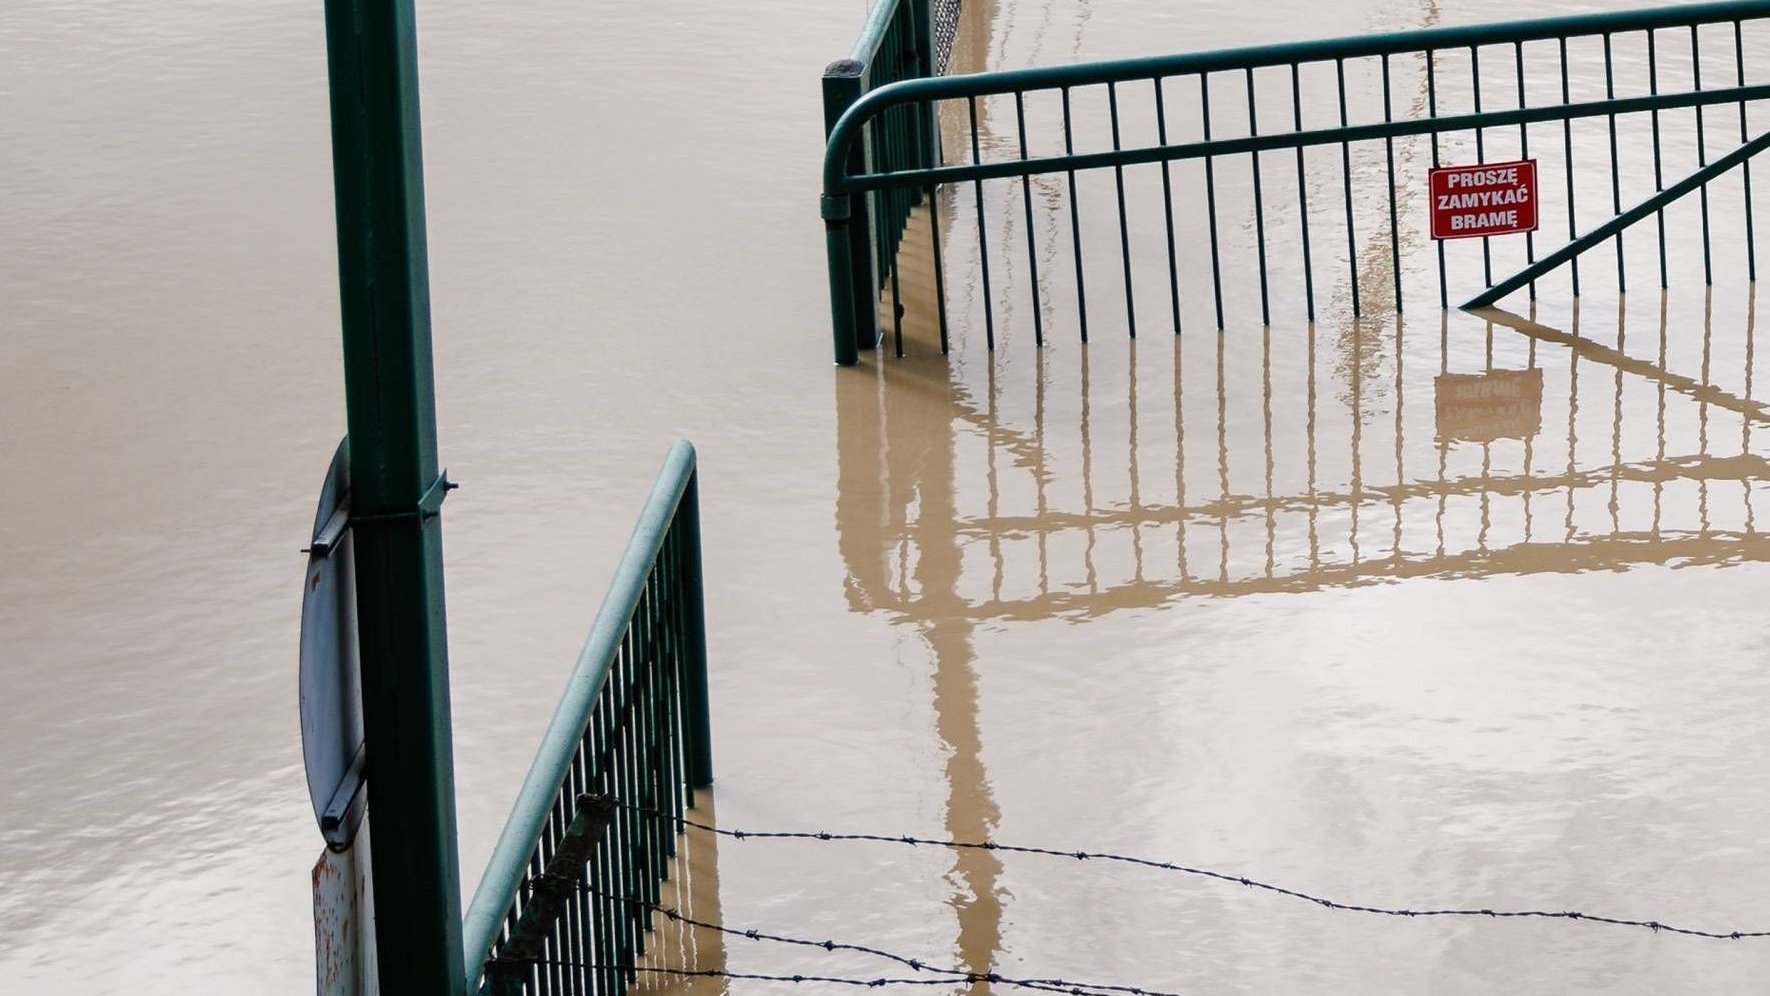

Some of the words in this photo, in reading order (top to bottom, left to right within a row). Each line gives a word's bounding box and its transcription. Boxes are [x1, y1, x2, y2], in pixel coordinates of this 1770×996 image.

[1447, 168, 1518, 188] PROSZĘ
[1438, 184, 1528, 210] ZAMYKAĆ
[1451, 210, 1518, 230] BRAMĘ
